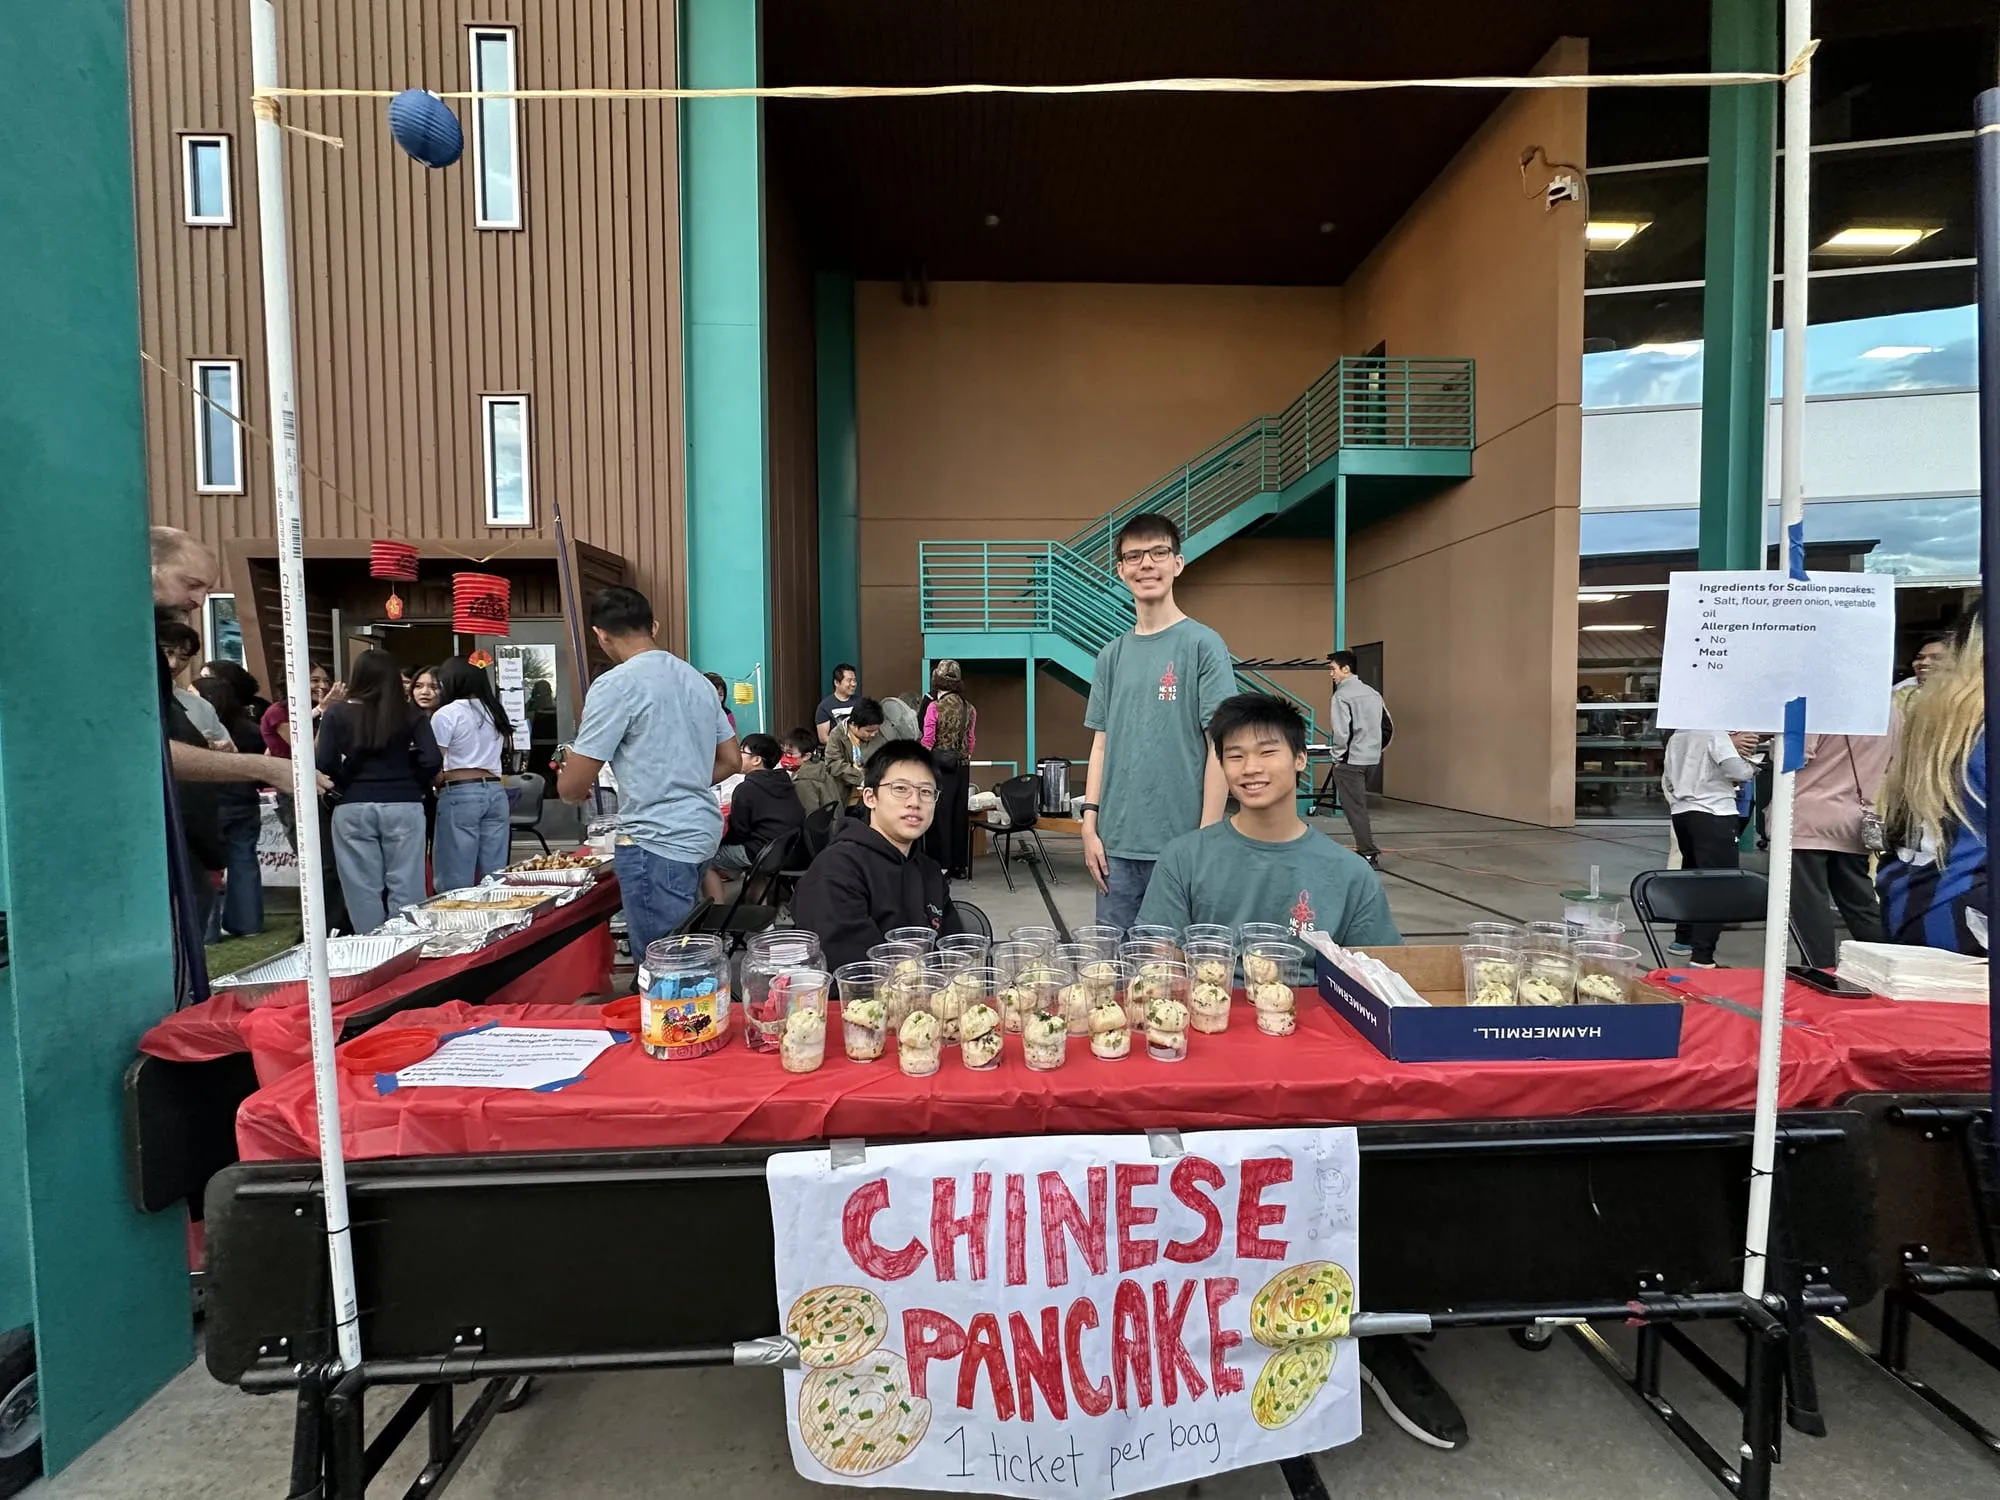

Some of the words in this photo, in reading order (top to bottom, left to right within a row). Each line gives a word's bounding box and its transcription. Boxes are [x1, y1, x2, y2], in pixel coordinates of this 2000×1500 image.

[1699, 583, 1766, 593] Ingredients
[1768, 583, 1785, 592] for
[1786, 583, 1827, 593] Scallion
[1828, 585, 1875, 595] pancakes:
[1713, 597, 1739, 606] Salt,
[1742, 597, 1769, 606] flour,
[1772, 598, 1802, 607] green
[1804, 598, 1832, 607] onion,
[1834, 599, 1876, 608] vegetable
[1702, 609, 1716, 618] oil
[1701, 622, 1749, 632] Allergen
[1751, 622, 1816, 632] Information
[1710, 635, 1726, 644] No
[1699, 648, 1728, 657] Meat
[282, 573, 295, 684] CHARLOTTE
[289, 696, 299, 744] PIPE
[1707, 661, 1723, 670] No
[842, 1155, 1294, 1288] CHINESE
[902, 1276, 1246, 1423] PANCAKE
[944, 1426, 975, 1478] 1
[989, 1430, 1085, 1488] ticket
[1110, 1431, 1156, 1492] per
[1170, 1418, 1221, 1464] bag
